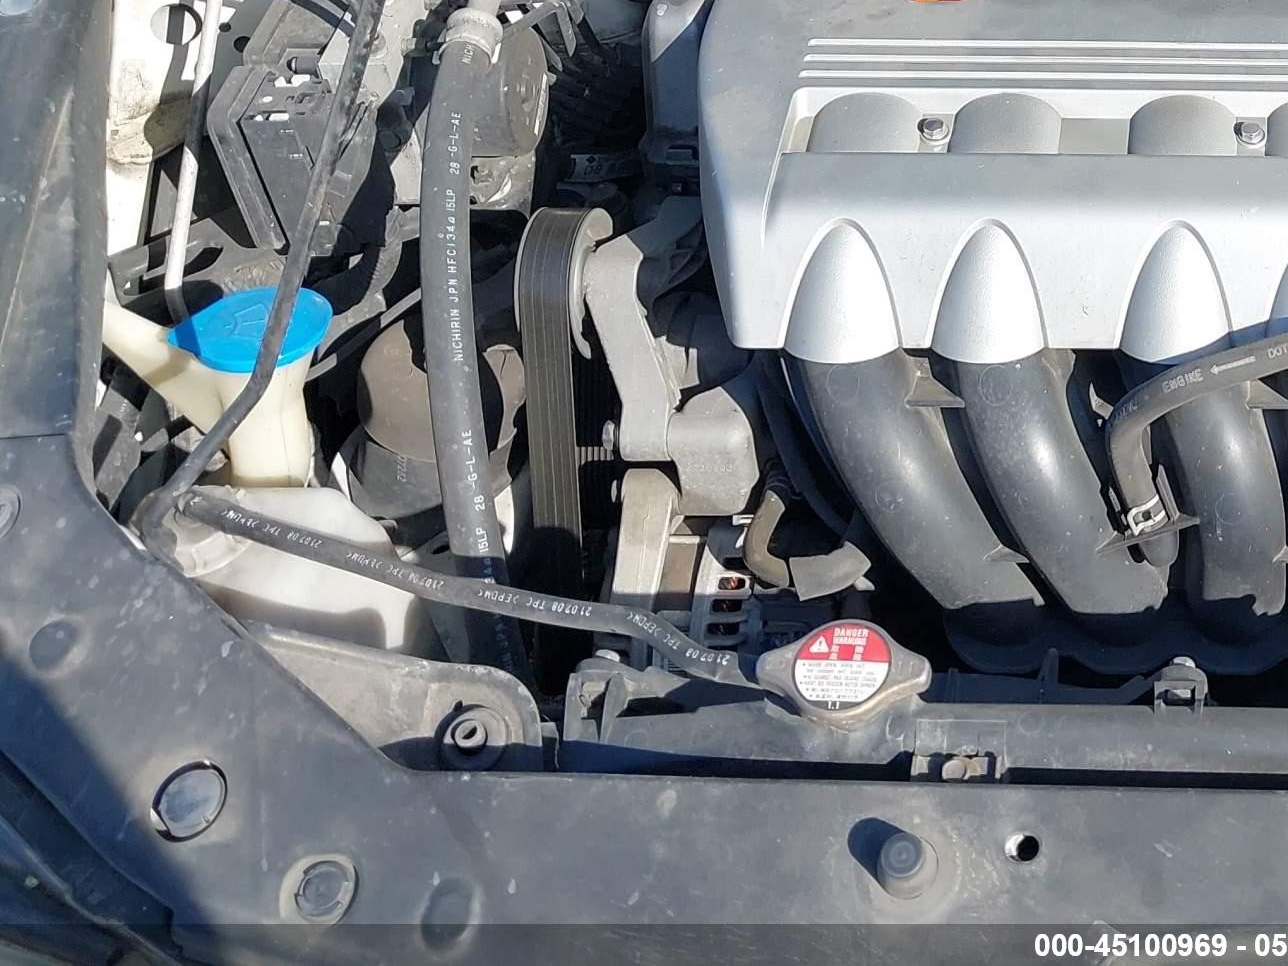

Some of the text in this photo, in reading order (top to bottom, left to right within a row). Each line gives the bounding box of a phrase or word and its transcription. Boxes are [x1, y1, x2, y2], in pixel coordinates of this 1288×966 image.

[449, 161, 461, 175] 28
[448, 278, 459, 303] JPN
[450, 309, 464, 361] NICHIRIN
[1267, 346, 1288, 360] DOT
[474, 494, 486, 511] 28
[526, 599, 546, 611] TPC
[834, 627, 869, 638] DANGER
[662, 633, 681, 650] TPC
